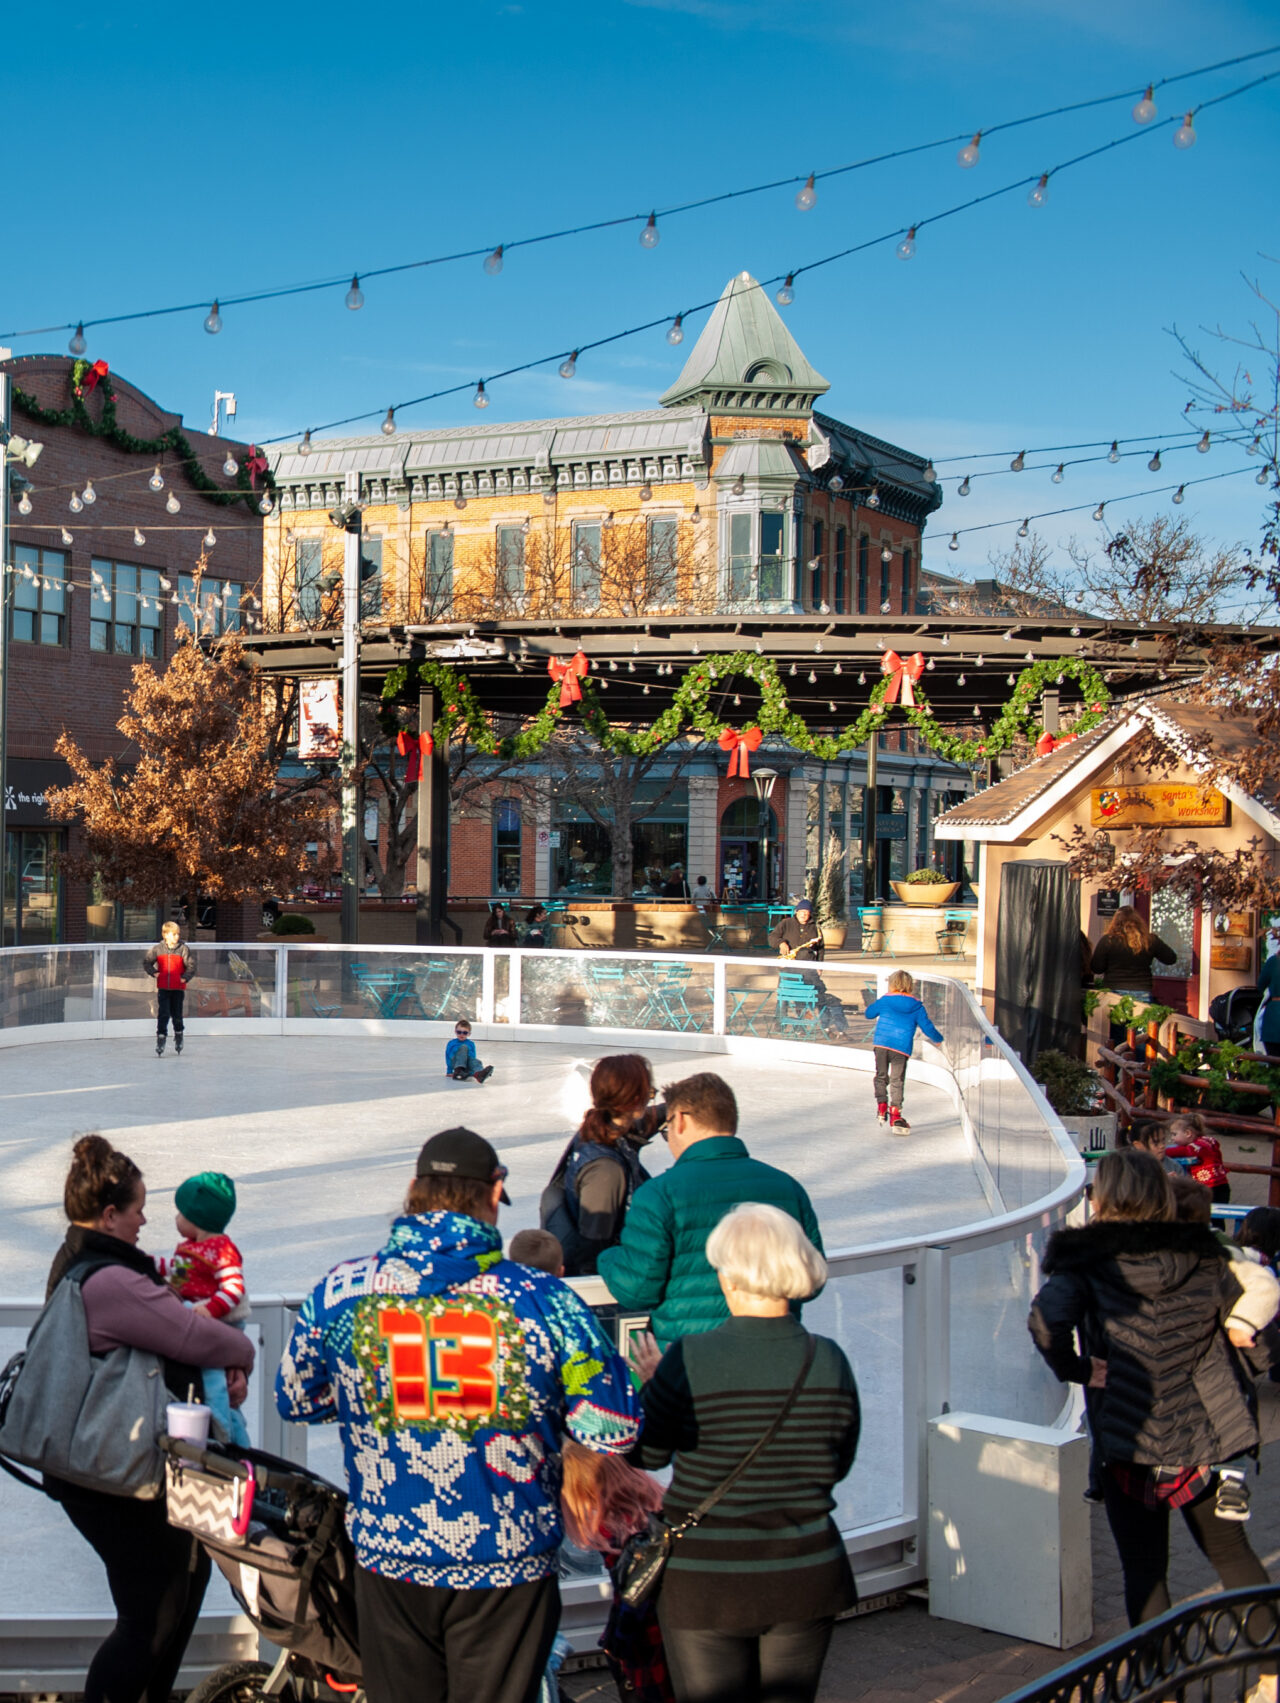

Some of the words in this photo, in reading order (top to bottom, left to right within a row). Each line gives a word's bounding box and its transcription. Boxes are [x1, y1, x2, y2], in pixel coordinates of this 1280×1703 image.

[18, 792, 30, 803] the
[1162, 790, 1193, 801] Santa's
[1178, 805, 1220, 817] Workshop
